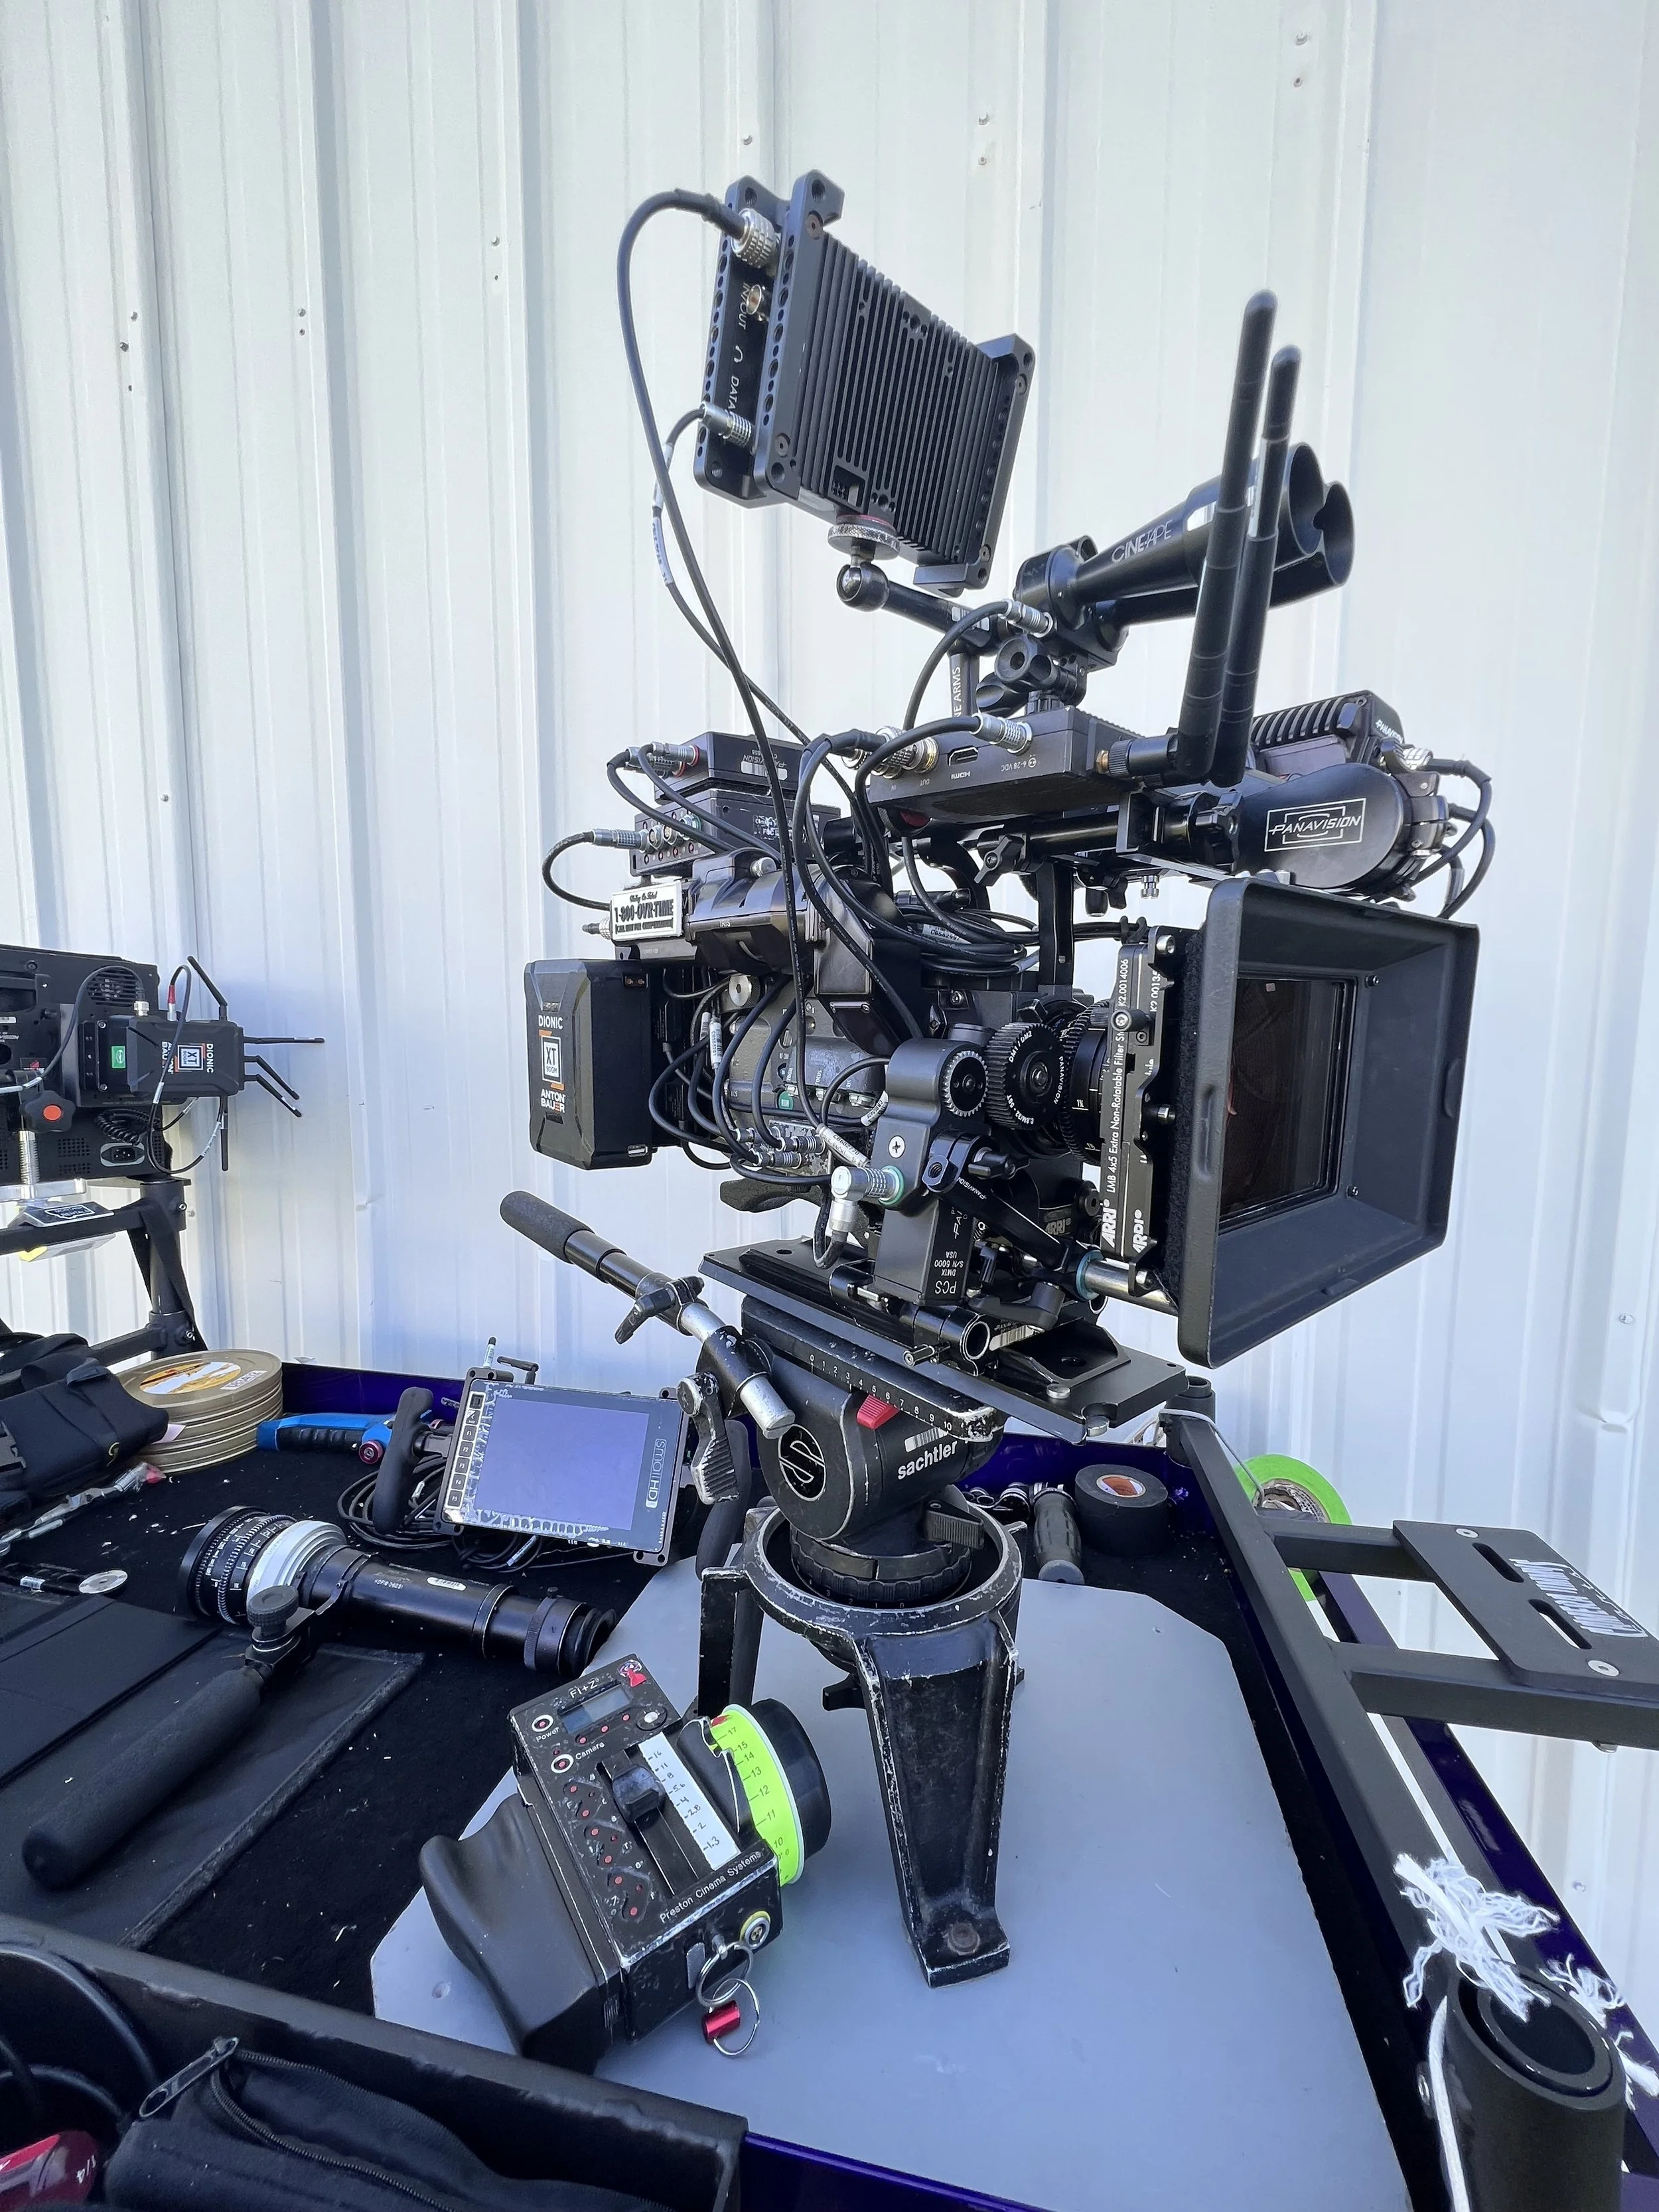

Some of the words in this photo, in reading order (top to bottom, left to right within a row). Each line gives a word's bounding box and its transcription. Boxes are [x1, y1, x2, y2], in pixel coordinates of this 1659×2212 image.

[728, 375, 739, 410] DATA
[952, 666, 961, 701] ARMS
[951, 771, 971, 780] HDMI
[1001, 763, 1016, 772] VDC
[1268, 816, 1362, 835] PANAVISION
[614, 899, 674, 922] 1-800-OVR-TIME
[1118, 959, 1129, 1006] K2.0014006
[538, 1015, 563, 1029] DIONIC
[1008, 1045, 1019, 1063] DM1
[1020, 1031, 1033, 1043] DM2
[1113, 1044, 1124, 1066] Filter
[187, 1051, 198, 1065] XT
[545, 1047, 557, 1066] XT
[1053, 1056, 1064, 1104] PANAVISION
[541, 1088, 565, 1102] ANTON
[1110, 1069, 1123, 1130] Non-Rotatable
[541, 1098, 565, 1113] BAUER
[1108, 1132, 1119, 1155] Extra
[1108, 1155, 1118, 1174] 4x5
[957, 1177, 987, 1200] PANAVISION
[1106, 1175, 1116, 1193] LMB
[934, 1280, 957, 1294] PCS
[943, 1421, 952, 1431] 10
[897, 1441, 958, 1480] sachtler
[644, 1440, 665, 1501] smallHD
[536, 1727, 559, 1743] Power
[728, 1727, 737, 1735] 17
[575, 1741, 605, 1760] Camera
[737, 1741, 748, 1751] 15
[743, 1751, 755, 1763] 14
[751, 1766, 762, 1778] 13
[758, 1785, 770, 1797] 12
[766, 1809, 776, 1821] 11
[774, 1837, 783, 1849] 10
[660, 1897, 693, 1923] Preston
[695, 1875, 727, 1899] Cinema
[727, 1851, 762, 1878] Systems
